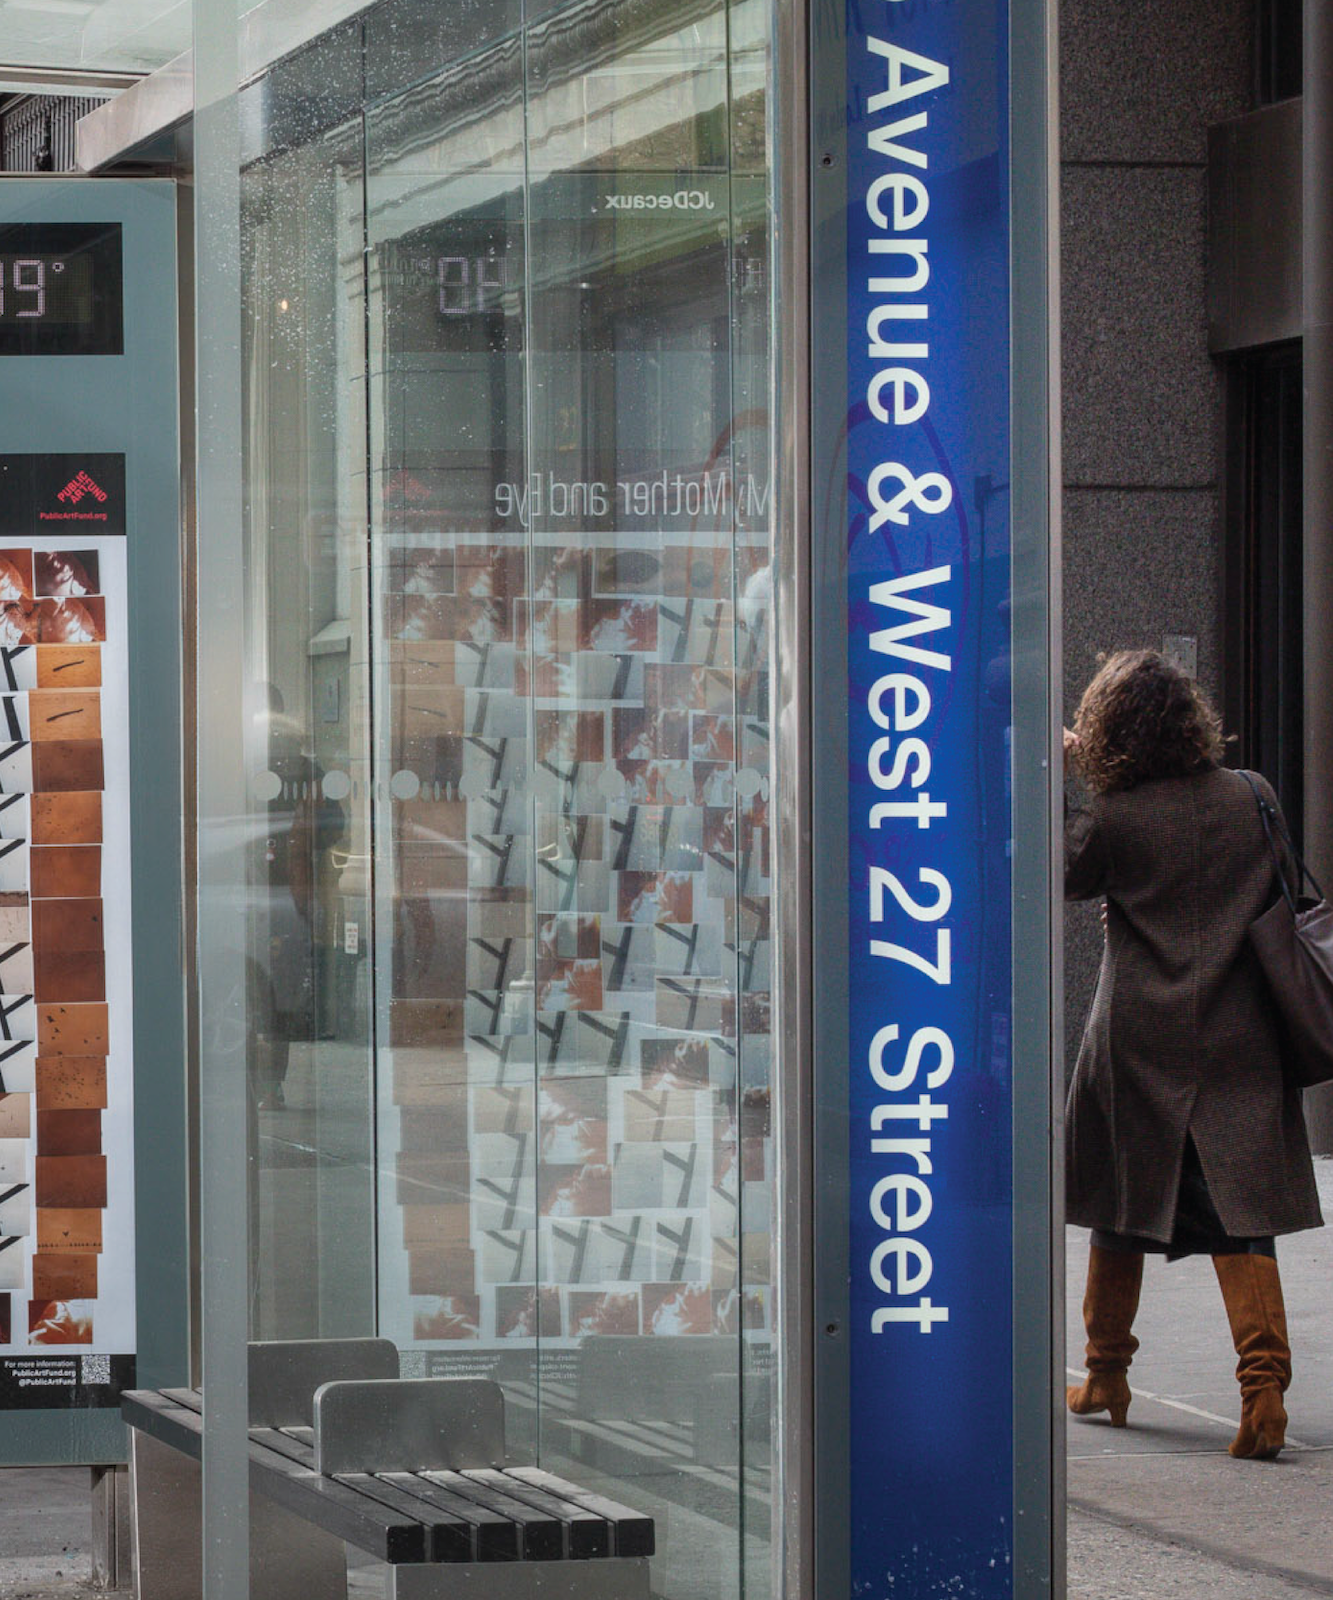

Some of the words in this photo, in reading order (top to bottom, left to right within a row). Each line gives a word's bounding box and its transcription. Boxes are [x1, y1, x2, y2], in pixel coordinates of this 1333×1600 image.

[865, 36, 950, 426] Avenue
[57, 469, 89, 503] PUBLIC
[70, 483, 90, 505] ART
[85, 477, 108, 502] FUND
[867, 461, 953, 534] &
[40, 511, 108, 521] PublicArtFund.org
[867, 565, 952, 829] West
[868, 868, 953, 985] 27
[867, 1022, 955, 1335] Street
[12, 1369, 77, 1378] PublicArtFund.org
